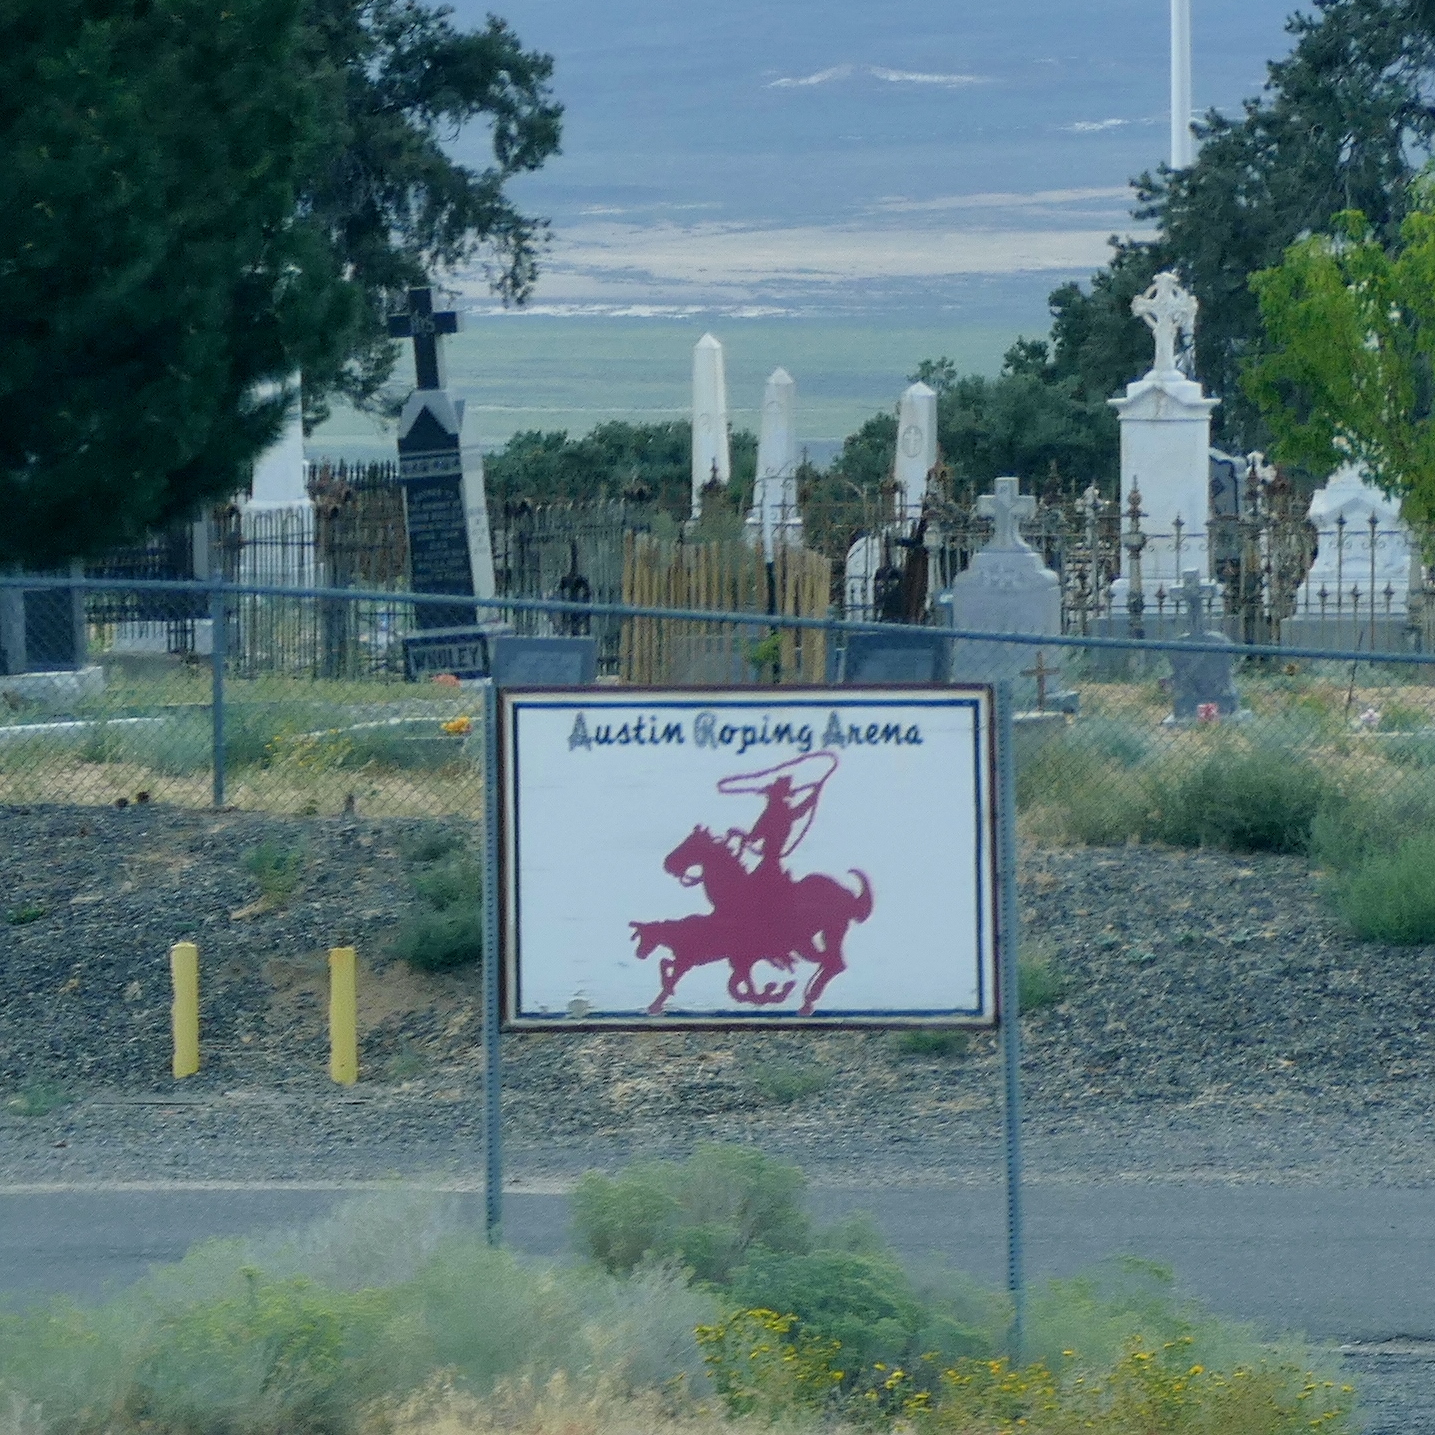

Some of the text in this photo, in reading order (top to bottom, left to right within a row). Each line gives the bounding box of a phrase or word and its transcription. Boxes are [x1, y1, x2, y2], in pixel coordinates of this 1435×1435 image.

[568, 710, 924, 755] Austin Roping Arena
